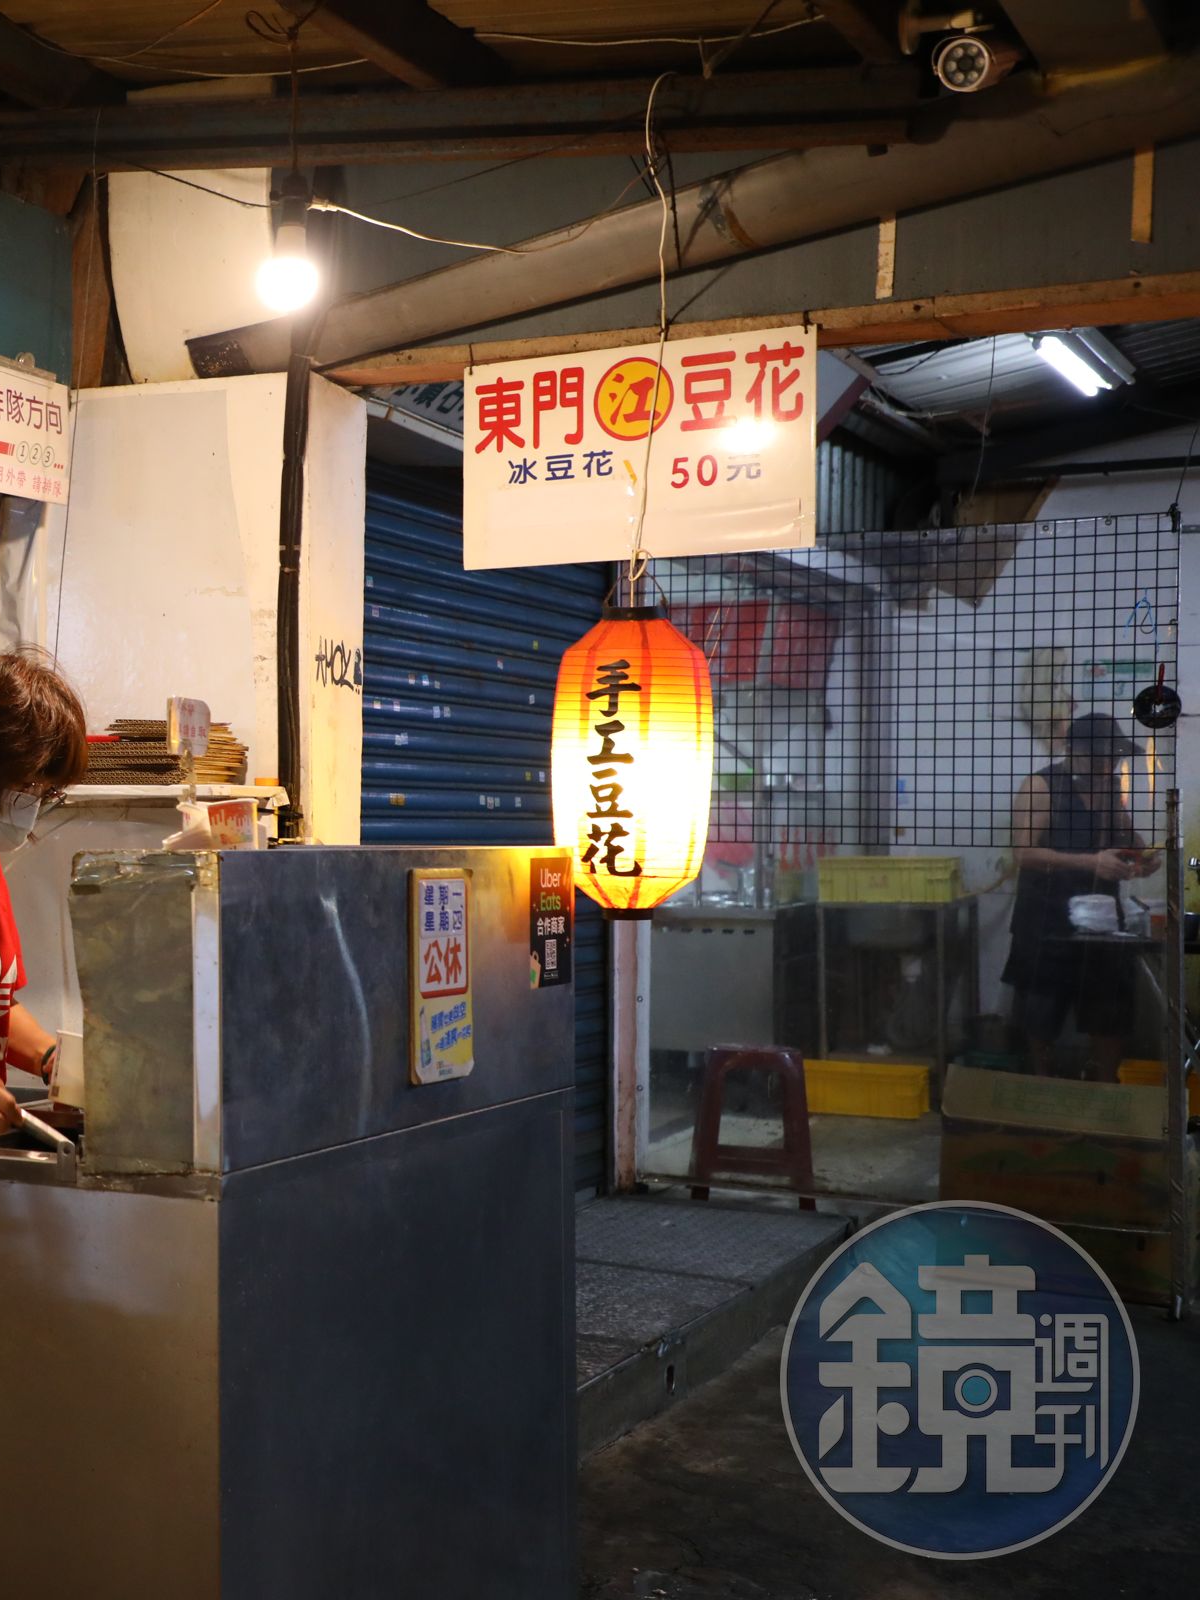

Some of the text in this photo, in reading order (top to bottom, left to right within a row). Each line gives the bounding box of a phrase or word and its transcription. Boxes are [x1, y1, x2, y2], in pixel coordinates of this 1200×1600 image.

[508, 450, 614, 485] 冰豆花
[31, 474, 63, 498] 請排隊
[582, 659, 643, 877] 手工豆花
[540, 868, 562, 889] Uber
[540, 892, 562, 912] Eats
[536, 915, 566, 937] 合作商家
[424, 938, 462, 985] 公休
